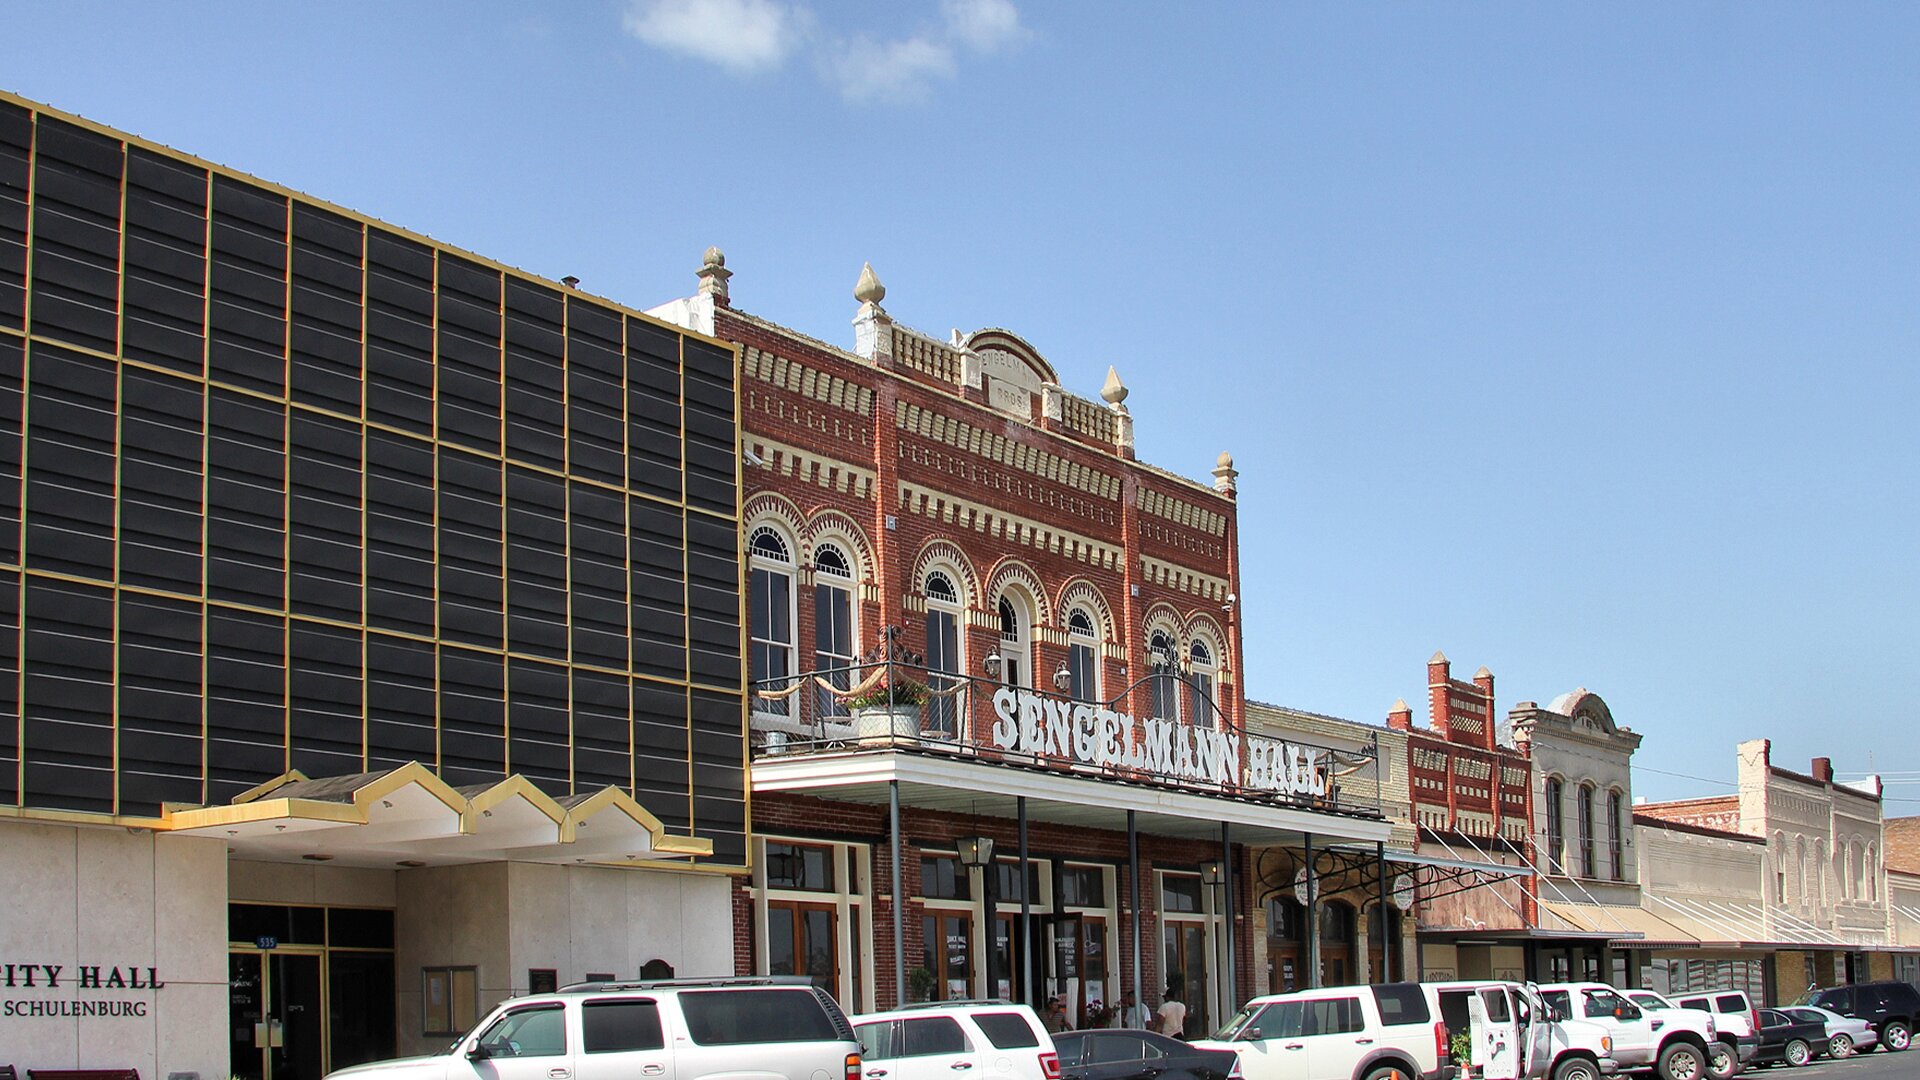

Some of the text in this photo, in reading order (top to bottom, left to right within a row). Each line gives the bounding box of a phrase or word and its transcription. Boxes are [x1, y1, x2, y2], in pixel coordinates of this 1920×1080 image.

[992, 688, 1325, 797] SENGELMANN HALL
[260, 938, 274, 948] 535
[0, 964, 165, 989] ITY HALL
[4, 1000, 147, 1017] SCHULENBURG
